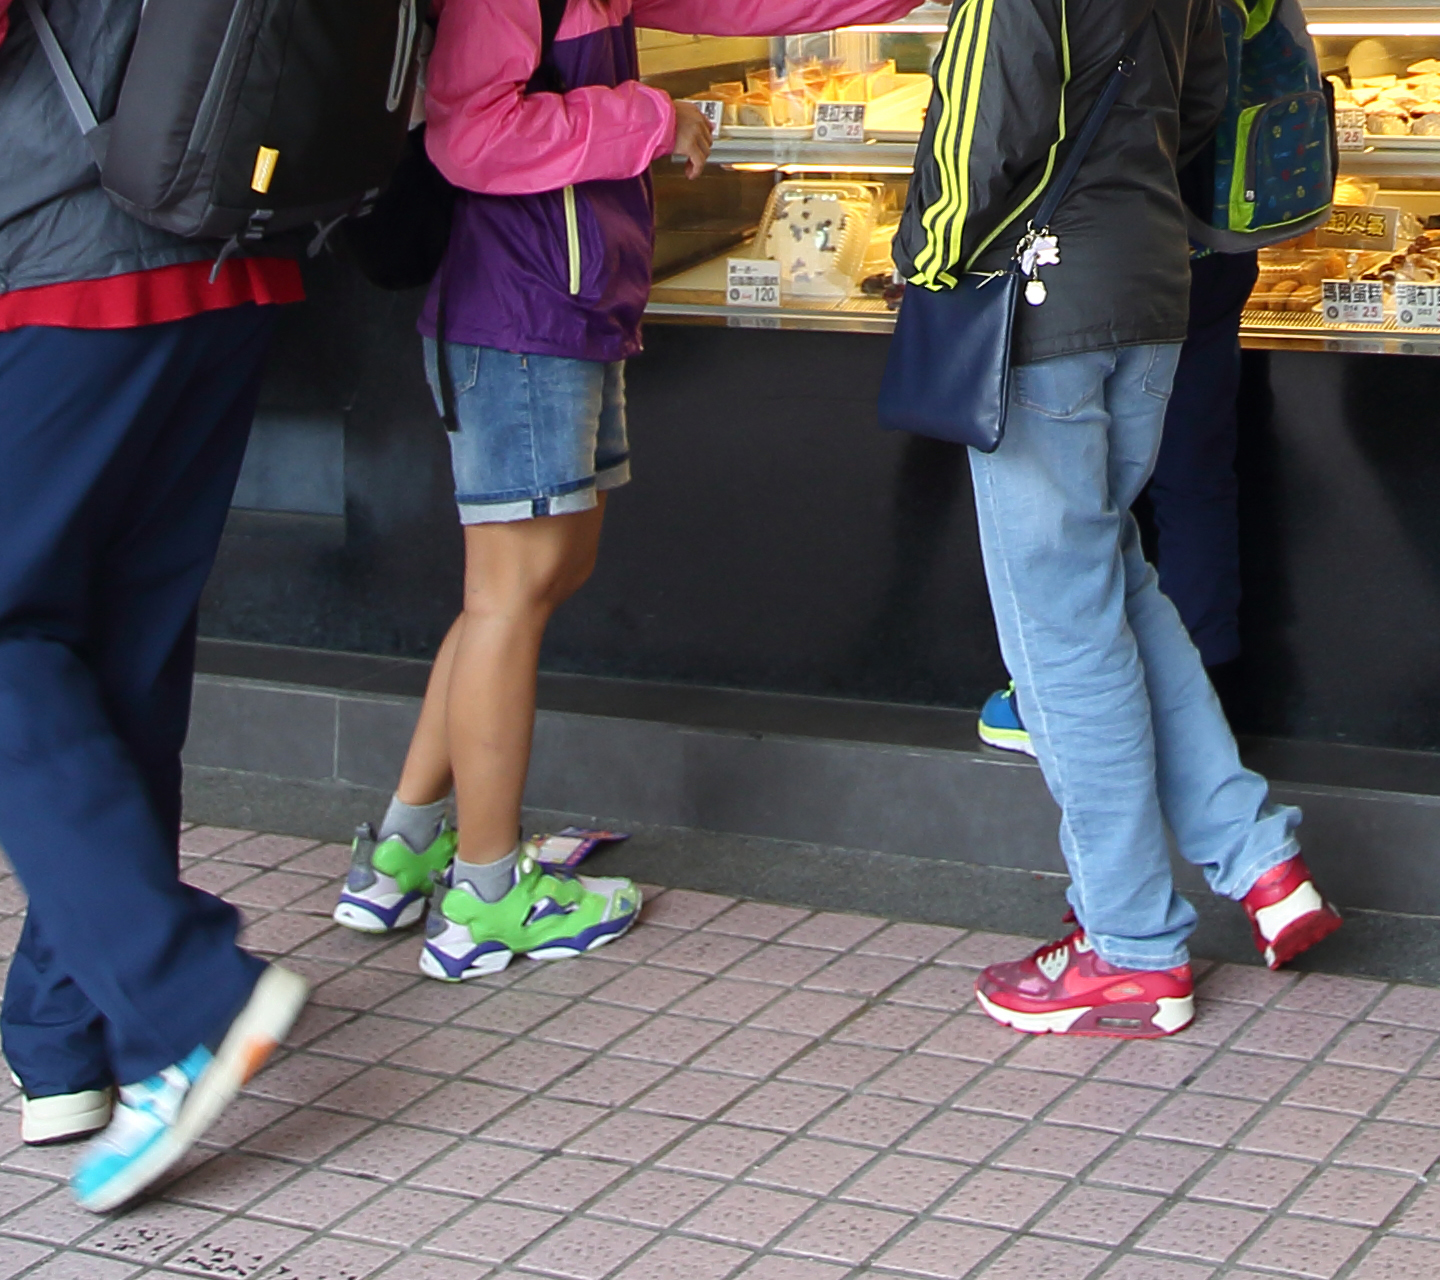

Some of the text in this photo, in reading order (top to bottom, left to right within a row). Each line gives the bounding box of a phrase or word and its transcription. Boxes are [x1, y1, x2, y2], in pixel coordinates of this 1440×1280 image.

[846, 125, 860, 137] 25
[1343, 131, 1359, 143] 25
[1362, 306, 1378, 318] 25
